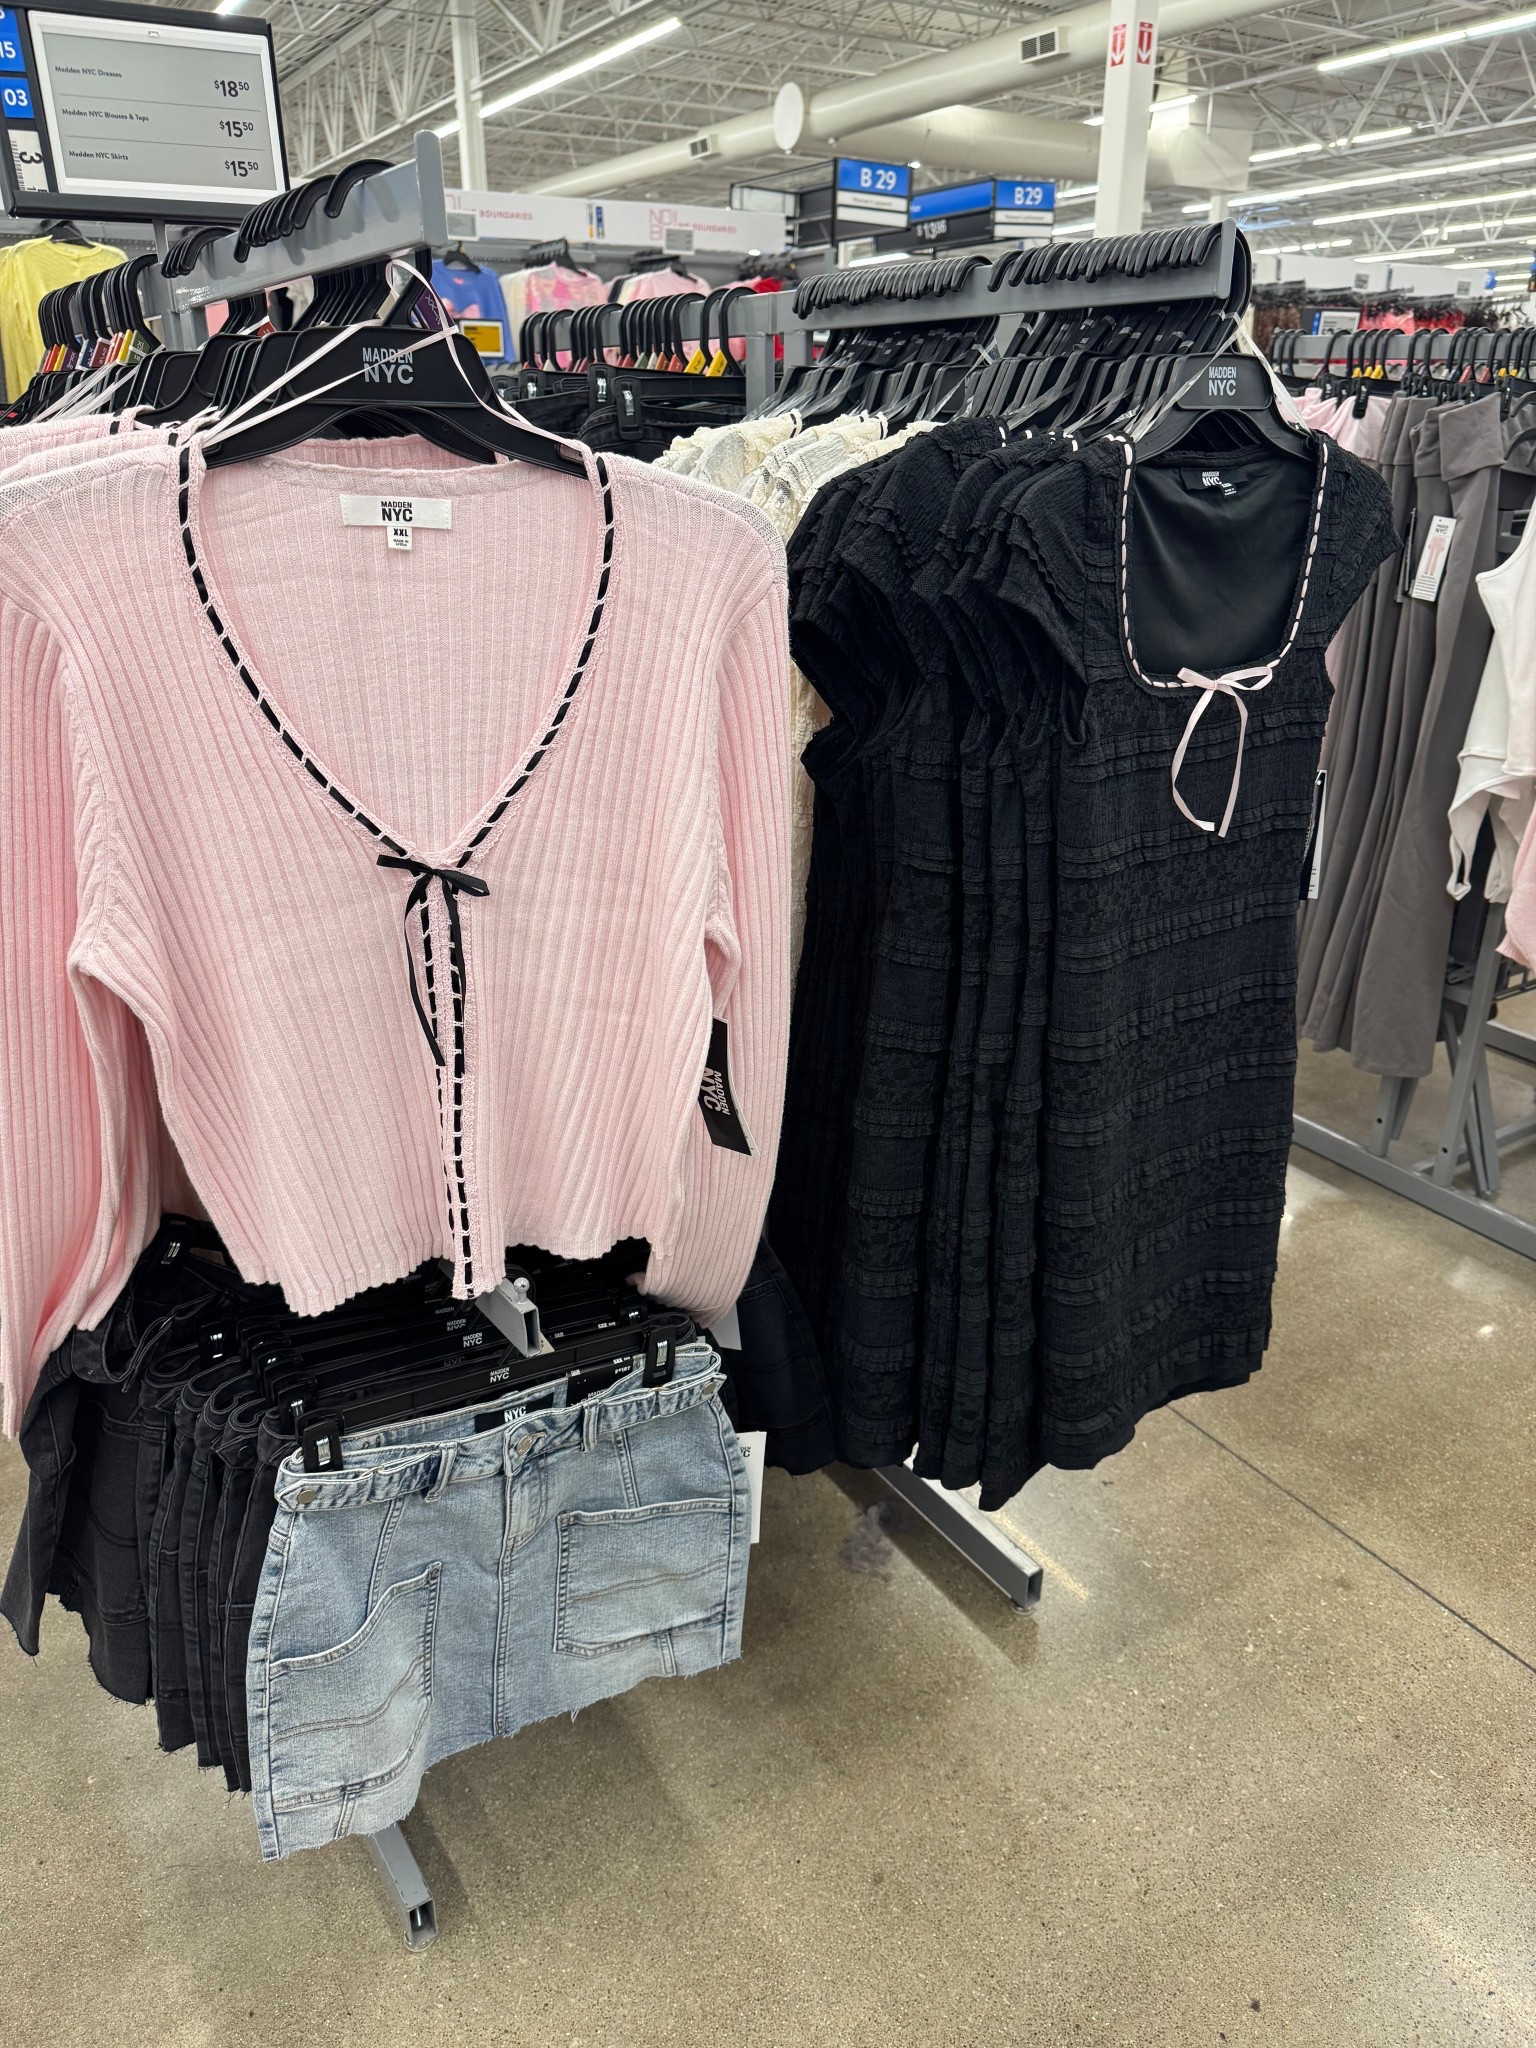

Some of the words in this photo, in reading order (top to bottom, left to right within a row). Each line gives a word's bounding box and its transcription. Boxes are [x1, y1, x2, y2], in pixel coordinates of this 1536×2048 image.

[55, 66, 81, 74] Madden
[98, 70, 122, 78] Dresses
[4, 88, 28, 106] 03
[62, 108, 87, 116] Madden
[105, 112, 128, 120] Blouses
[135, 114, 149, 122] Tops
[69, 150, 94, 158] Madden
[110, 152, 129, 160] Skirts
[860, 167, 872, 188] B
[875, 169, 897, 190] 29
[1014, 186, 1025, 206] B
[1025, 186, 1043, 206] 29
[362, 347, 413, 364] MADDEN
[363, 363, 414, 384] NYC
[1208, 366, 1237, 379] MADDEN
[1208, 379, 1237, 396] NYC
[1202, 476, 1222, 487] NYC
[381, 508, 413, 522] NYC
[393, 528, 409, 537] XXL
[700, 1067, 721, 1111] NYC
[714, 1070, 731, 1116] MADDEN
[435, 1306, 455, 1315] MADDEN
[446, 1319, 467, 1327] MADDEN
[462, 1332, 483, 1341] MADDEN
[463, 1337, 483, 1348] NYC
[489, 1366, 510, 1377] MADDEN
[489, 1371, 510, 1384] NYC
[504, 1405, 527, 1423] NYC
